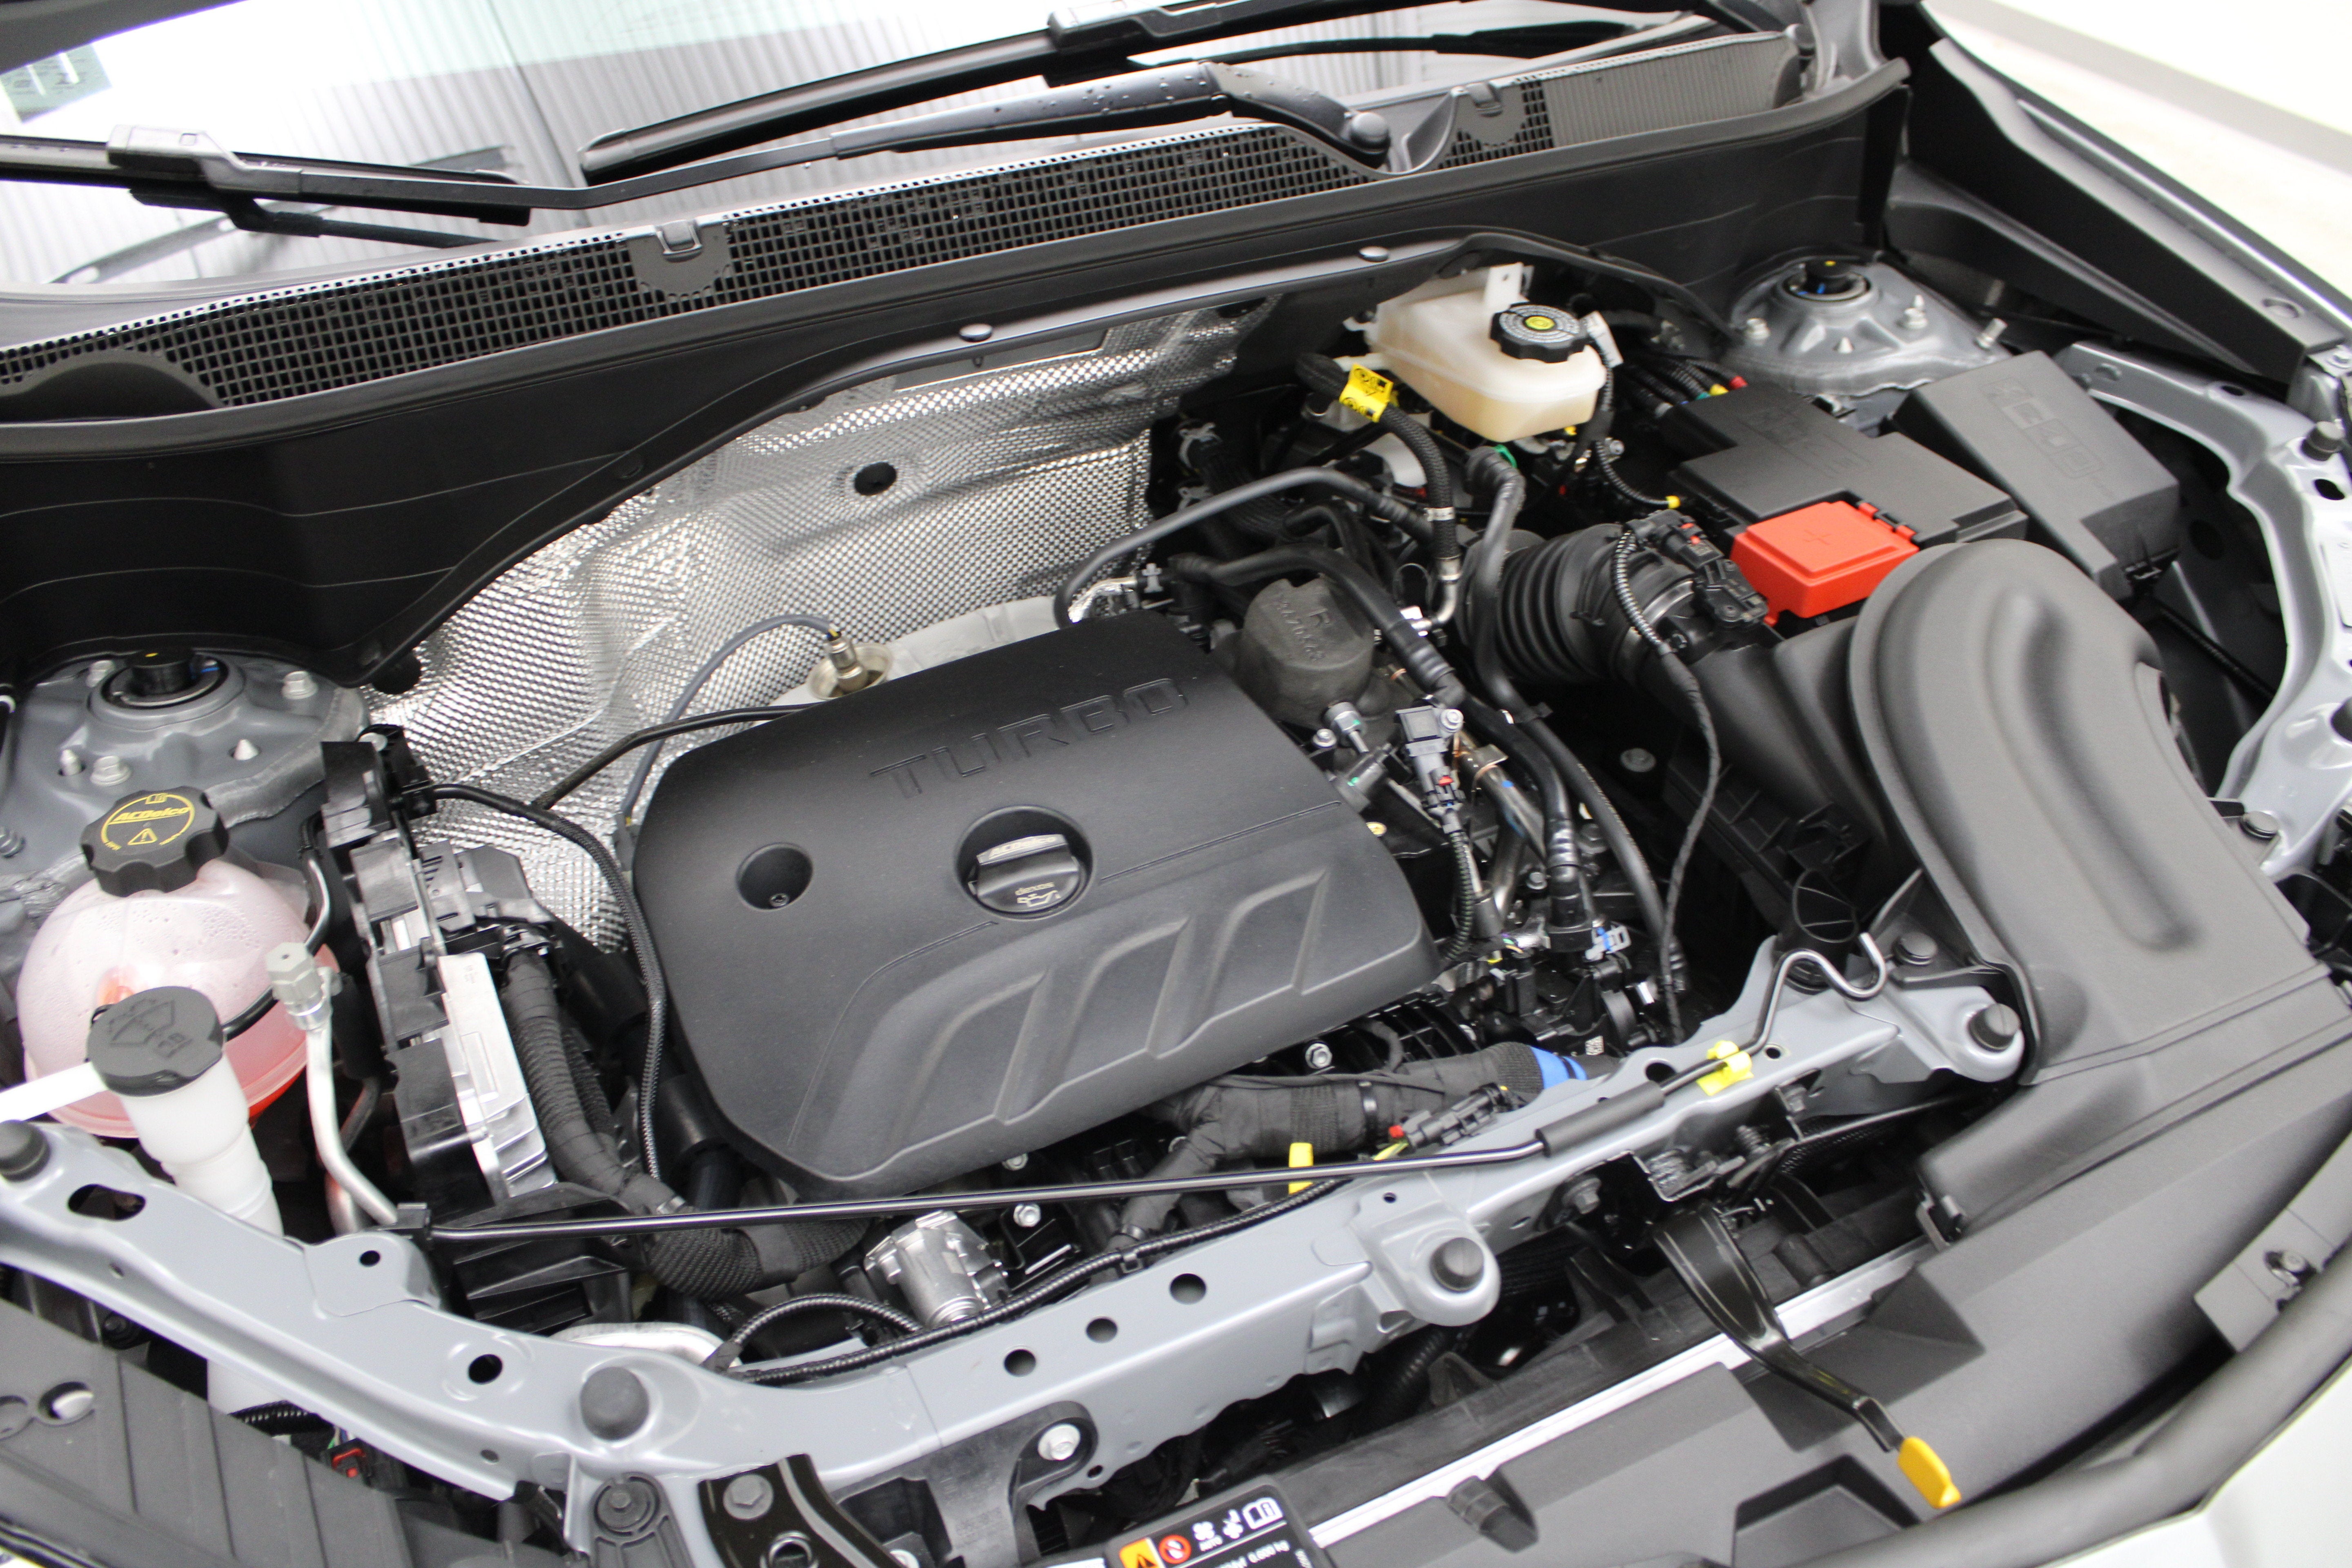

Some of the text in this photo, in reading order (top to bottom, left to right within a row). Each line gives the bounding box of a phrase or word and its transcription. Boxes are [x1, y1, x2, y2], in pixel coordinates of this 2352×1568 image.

[869, 678, 1189, 799] TURBO
[111, 807, 191, 822] ACDelco
[989, 836, 1057, 859] ACDelco
[1015, 882, 1055, 895] dexos
[1198, 1534, 1223, 1552] AUTO
[1272, 1539, 1290, 1552] kg
